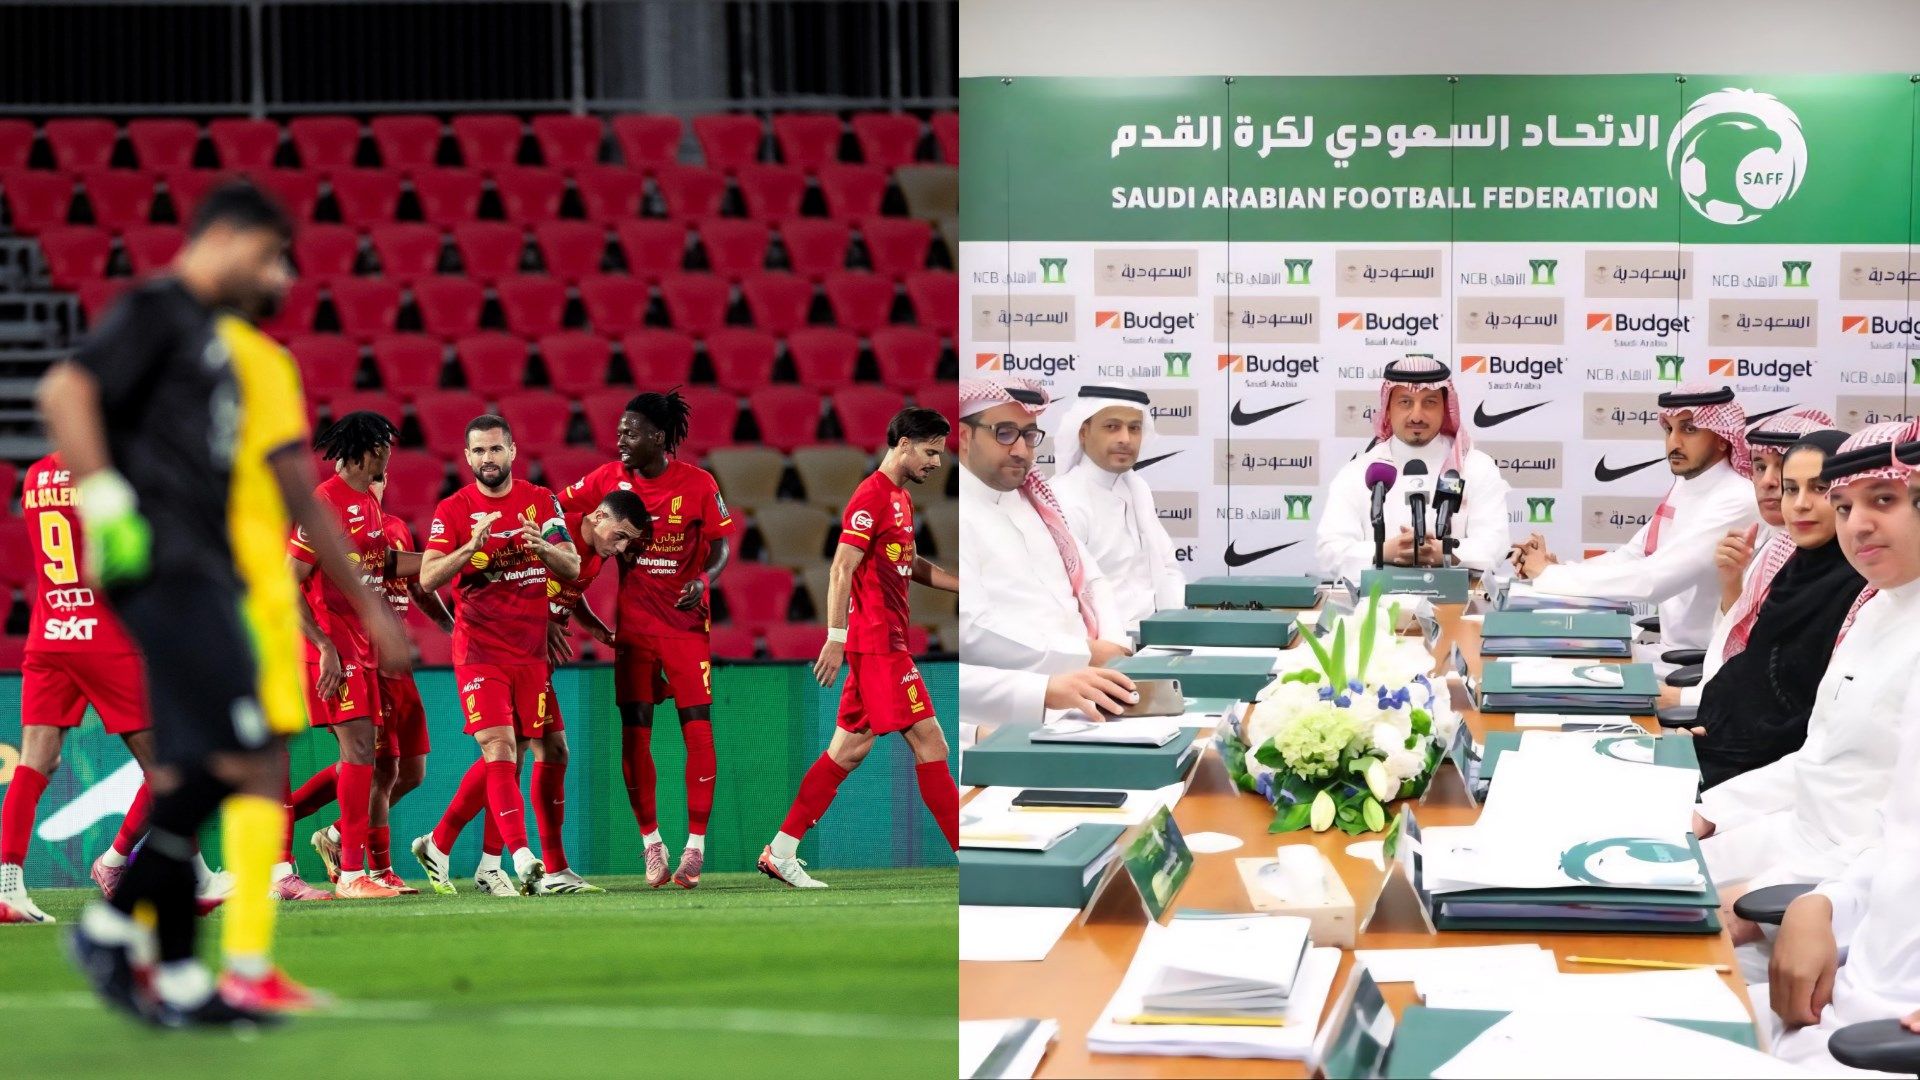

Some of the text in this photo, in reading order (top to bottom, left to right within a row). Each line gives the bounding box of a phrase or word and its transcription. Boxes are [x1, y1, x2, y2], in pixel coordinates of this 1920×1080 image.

[1111, 114, 1659, 168] الاتحاد السعودي لكرة القدم
[1743, 171, 1784, 186] SAFF
[1111, 186, 1658, 209] SAUDI ARABIAN FOOTBALL FEDERATION
[1868, 267, 1920, 286] عودية
[1123, 311, 1195, 334] Budget
[1365, 313, 1439, 335] Budget
[1615, 313, 1690, 336] Budget
[1003, 353, 1076, 376] Budget
[1246, 355, 1319, 376] Budget
[1489, 356, 1563, 379] Budget
[1737, 358, 1812, 382] Budget
[1150, 405, 1192, 421] السعو
[1611, 406, 1658, 426] عودية
[39, 510, 79, 585] 9
[650, 543, 684, 552] Aviation
[636, 556, 678, 567] Valvoline
[504, 567, 546, 581] Valvoline
[522, 577, 547, 586] aramco
[537, 692, 546, 718] 6
